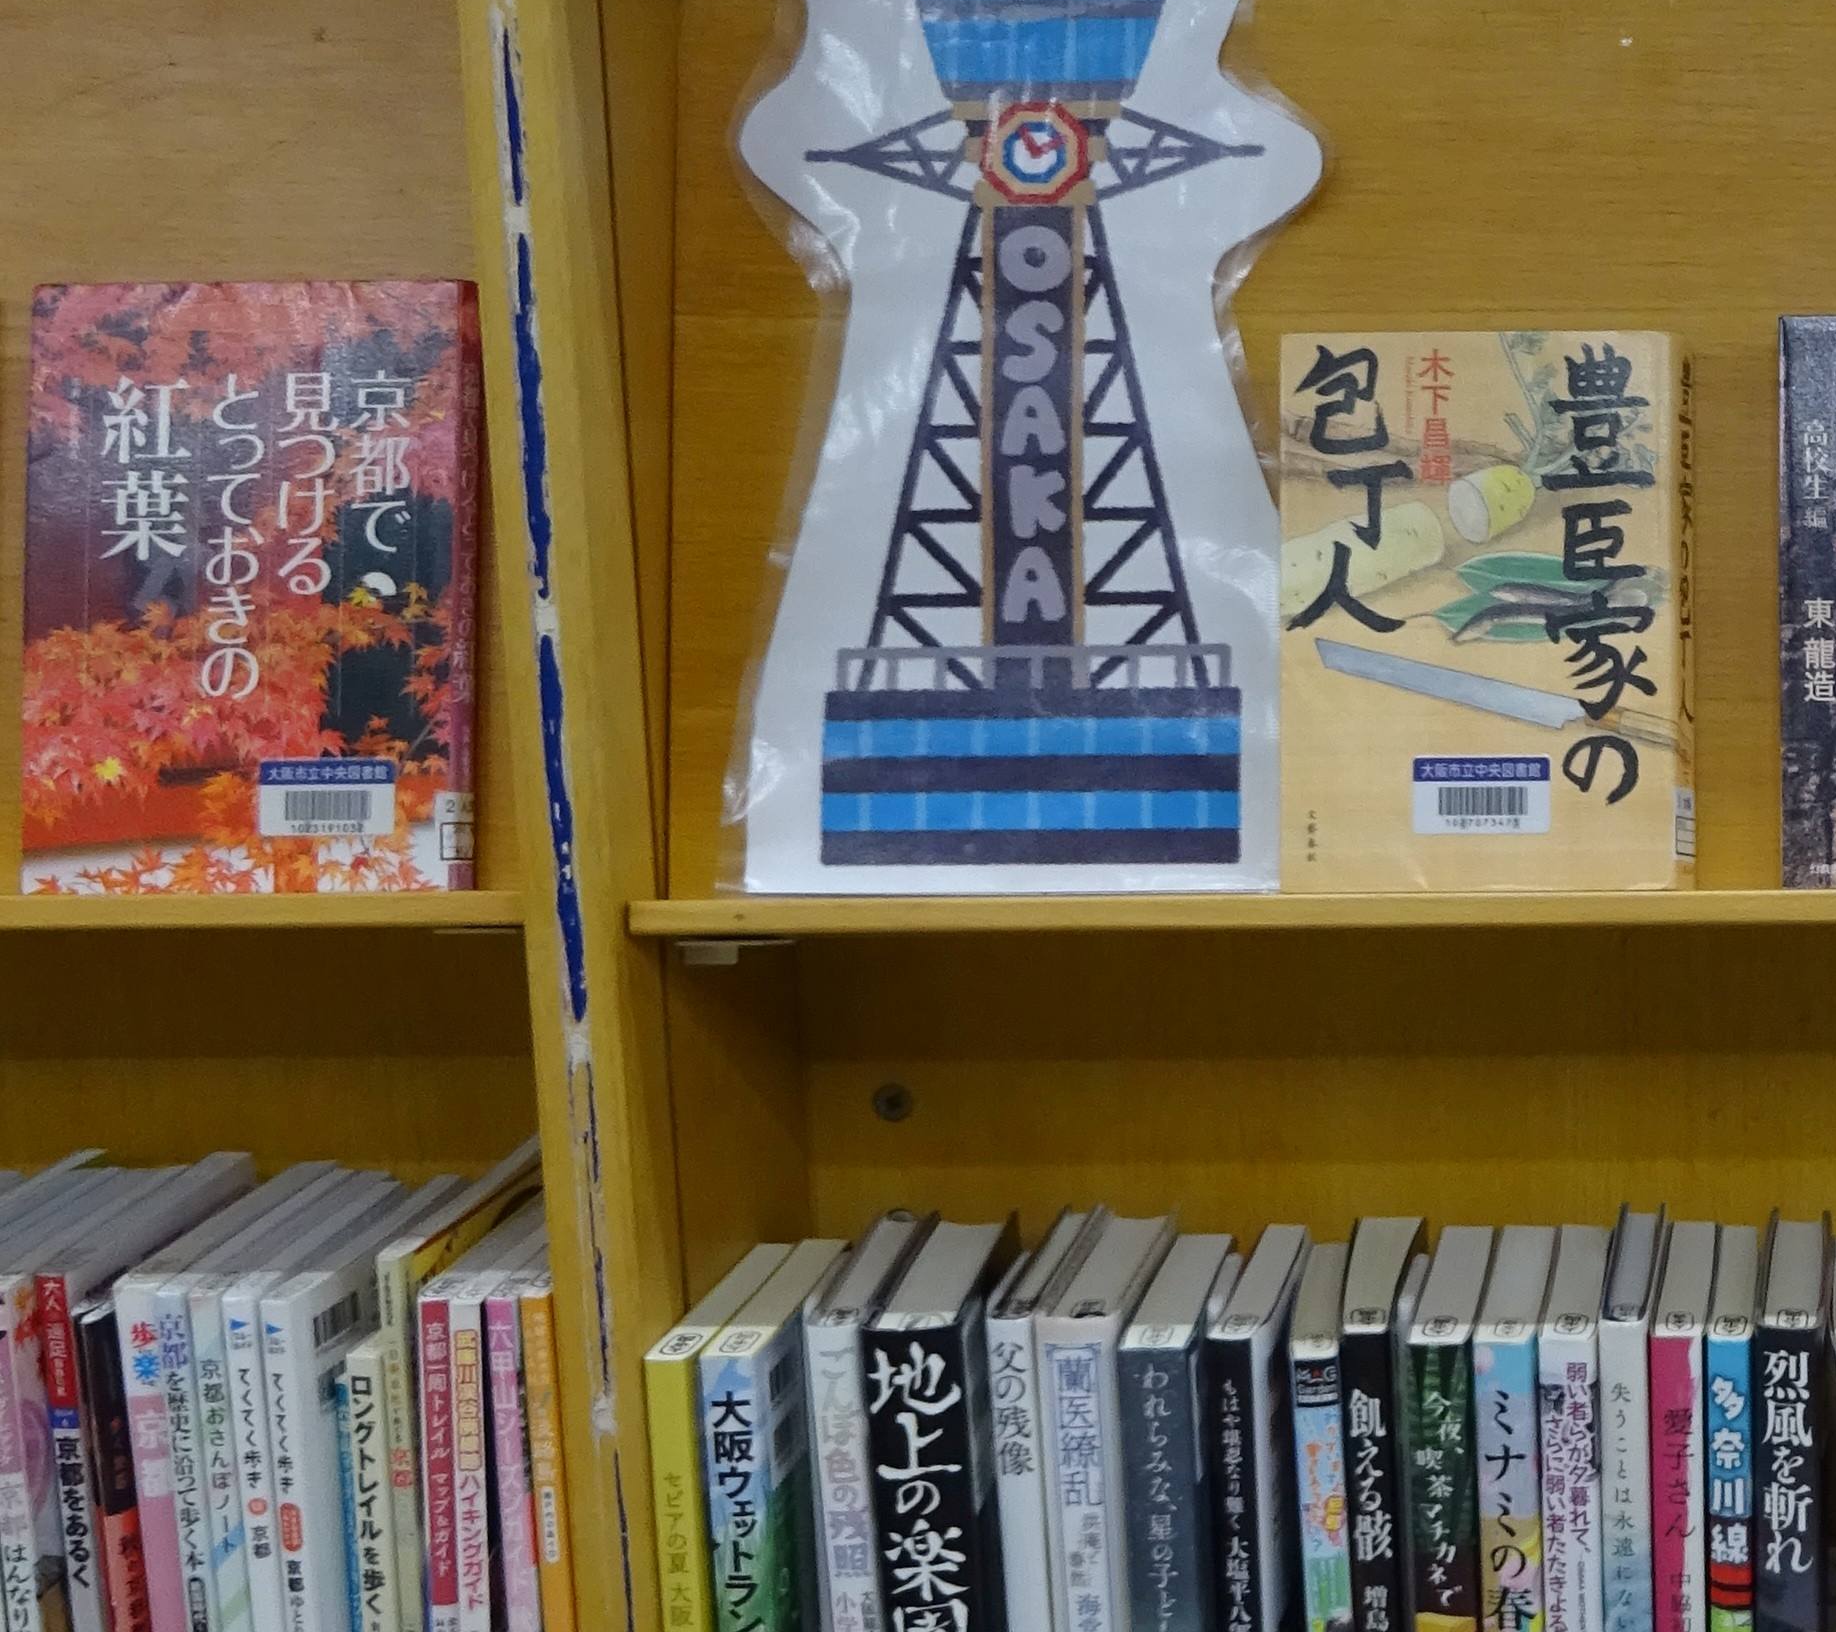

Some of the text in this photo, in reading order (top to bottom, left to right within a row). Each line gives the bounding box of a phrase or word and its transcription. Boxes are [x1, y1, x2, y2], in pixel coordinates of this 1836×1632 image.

[99, 377, 191, 562] 紅葉
[277, 371, 339, 596] 見つける
[350, 372, 411, 554] 京都で
[1002, 224, 1067, 621] OSAKA
[1286, 344, 1414, 634] 包丁人
[1416, 348, 1456, 485] 木下昌輝
[200, 373, 265, 700] とっておきの
[1541, 340, 1656, 806] 豊臣家の
[267, 765, 390, 783] 大阪市立中央図書館
[1420, 760, 1542, 781] 大阪市立中央図書館
[237, 1368, 264, 1489] てくてく歩き
[271, 1372, 295, 1495] てくてく歩き
[350, 1375, 387, 1616] ロングトレイルを歩く
[993, 1340, 1035, 1478] 父の残像
[1056, 1357, 1105, 1508] 蘭医繚乱
[1348, 1387, 1394, 1562] 飢える骸
[1415, 1390, 1466, 1608] 今夜、喫茶マチカネで
[1565, 1361, 1592, 1555] 弱い者らが夕暮れて、
[1663, 1408, 1698, 1540] 愛子さん
[1710, 1374, 1750, 1566] 多奈川線
[1761, 1348, 1814, 1575] 烈風を斬れ
[55, 1437, 90, 1589] 京都をあるく
[1484, 1388, 1539, 1631] ミナミの春
[1609, 1380, 1635, 1630] 失うことは永遠にない
